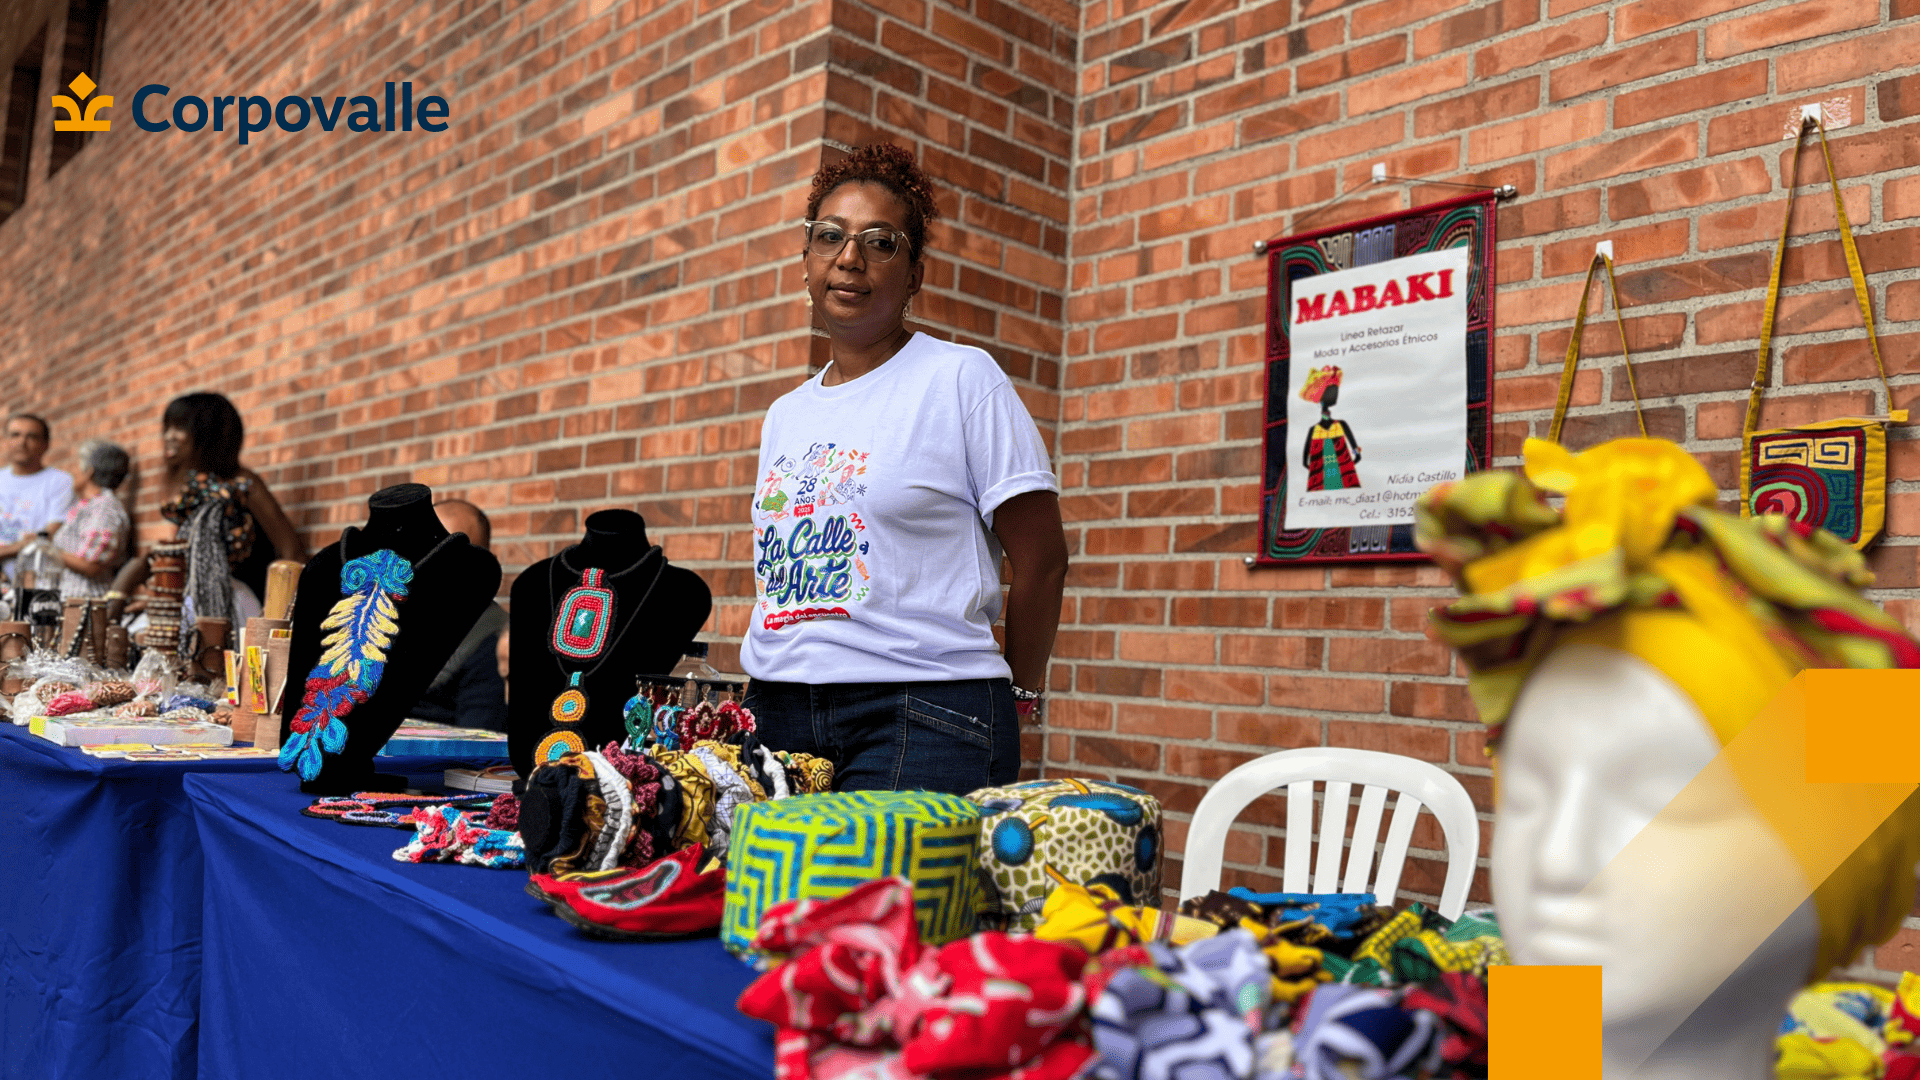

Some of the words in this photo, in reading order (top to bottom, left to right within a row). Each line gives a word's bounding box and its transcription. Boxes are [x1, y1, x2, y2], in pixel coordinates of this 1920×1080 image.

[1295, 268, 1455, 325] MABAKI
[1367, 324, 1404, 337] Retazar
[1313, 347, 1339, 359] Moda
[1341, 347, 1347, 356] y
[1348, 337, 1400, 353] Accesorios
[1402, 332, 1438, 345] Étnicos
[1387, 475, 1414, 485] Nidia
[1417, 470, 1457, 483] Castillo
[797, 478, 817, 495] 28
[794, 495, 816, 505] AÑOS
[1298, 496, 1332, 507] E-mail:
[1386, 506, 1414, 519] 3152
[757, 525, 786, 576] La
[787, 516, 857, 561] Calle
[766, 565, 787, 596] del
[777, 557, 852, 607] Arte
[773, 613, 794, 624] magia
